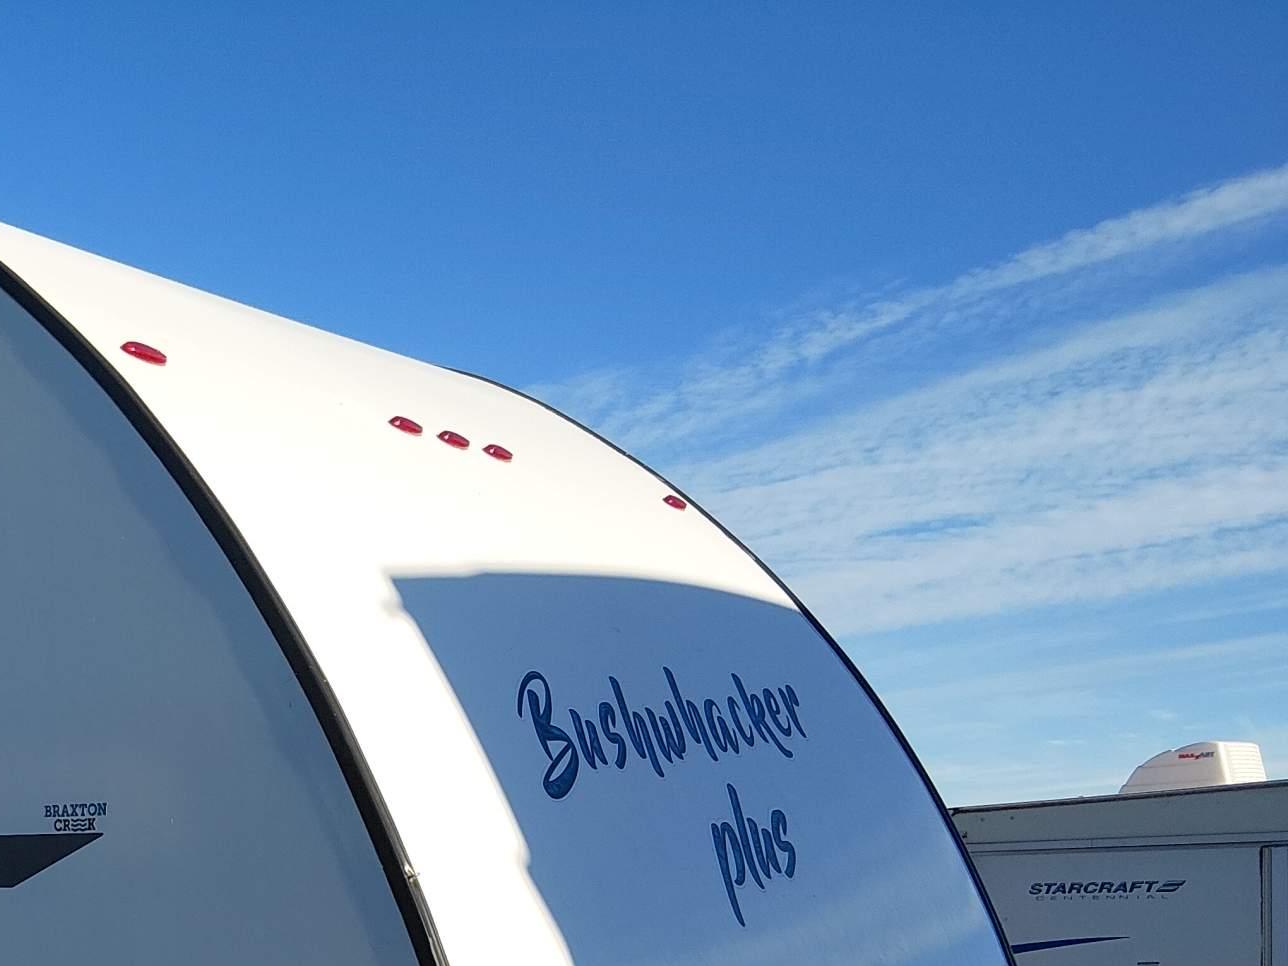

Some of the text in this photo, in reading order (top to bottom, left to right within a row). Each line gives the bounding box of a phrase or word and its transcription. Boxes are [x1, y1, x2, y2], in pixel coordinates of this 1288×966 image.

[517, 666, 807, 799] Bushwhacker
[44, 803, 107, 817] BRAXTON
[711, 783, 796, 927] plus
[1028, 880, 1159, 895] STARCRAFT
